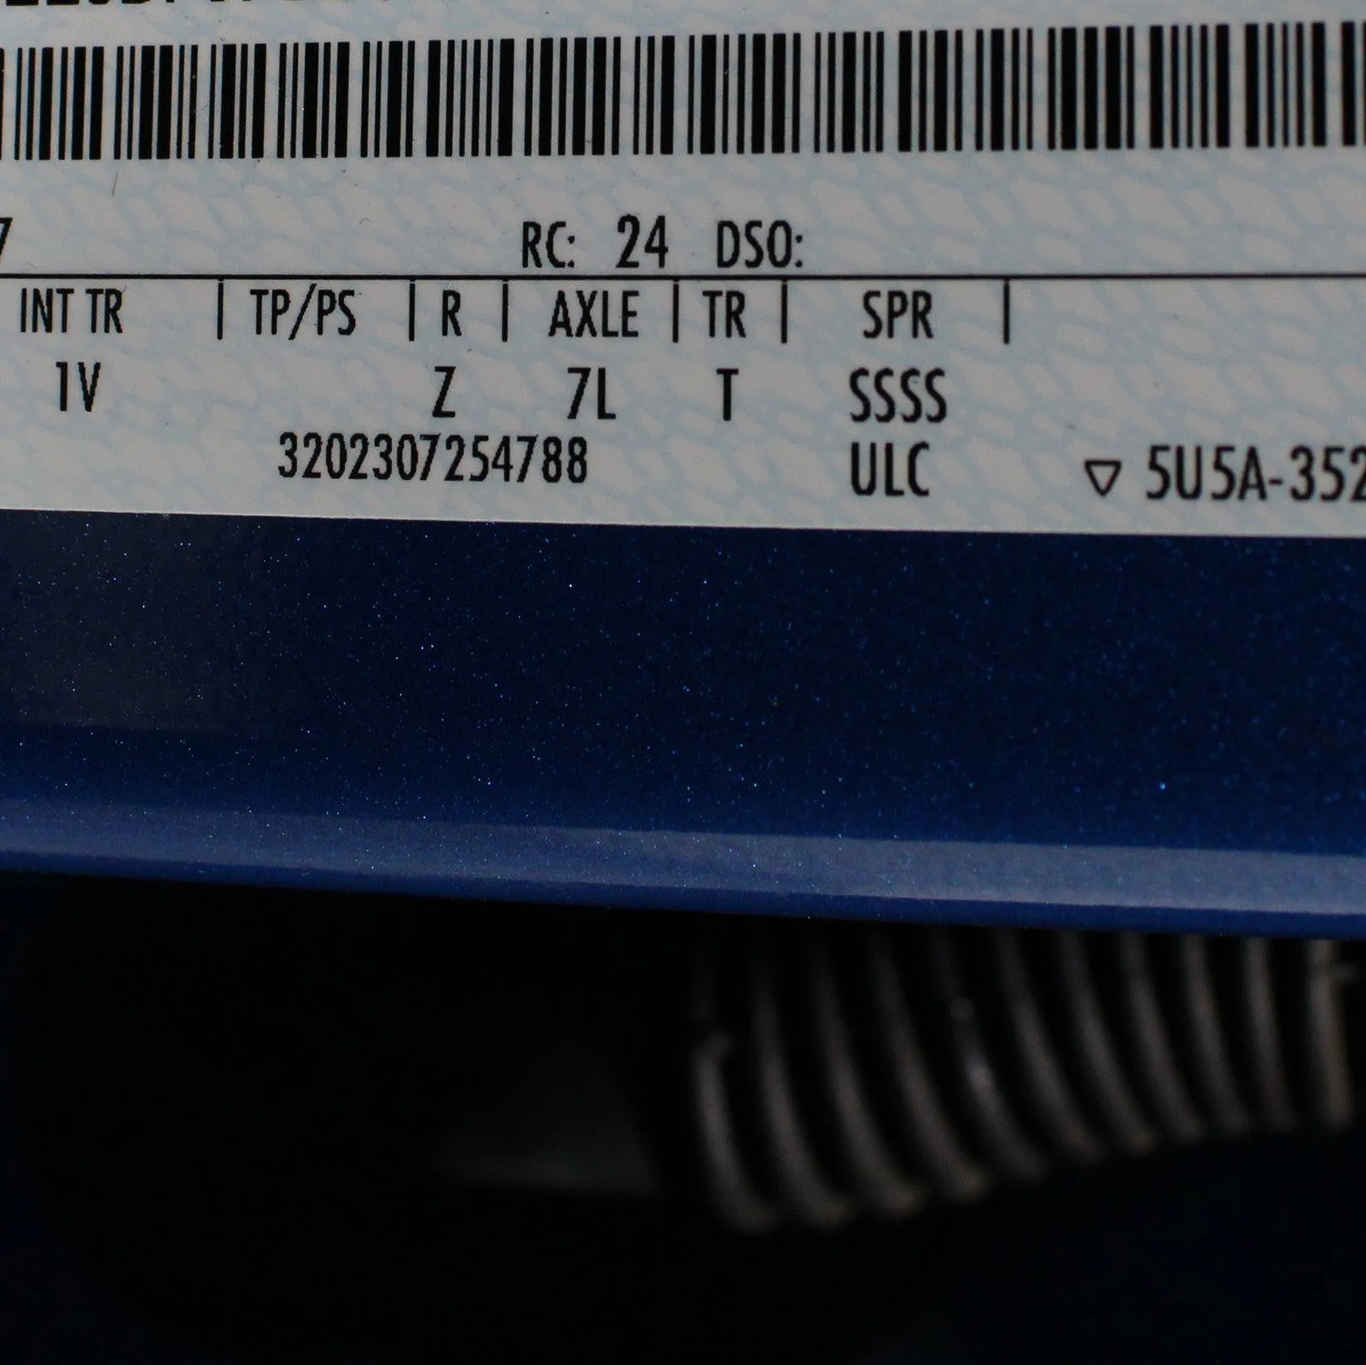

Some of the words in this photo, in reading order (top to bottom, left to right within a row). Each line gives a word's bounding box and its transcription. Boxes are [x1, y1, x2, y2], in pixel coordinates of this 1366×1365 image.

[522, 221, 575, 268] RC:
[616, 214, 668, 268] 24
[717, 220, 803, 268] DSO:
[21, 288, 74, 333] INT
[86, 288, 122, 333] TR
[250, 283, 356, 340] TP/PS
[442, 290, 462, 336] R
[548, 290, 639, 337] AXLE
[702, 290, 746, 338] TR
[863, 290, 933, 339] SPR
[56, 362, 101, 412] 1V
[432, 366, 456, 418] Z
[567, 367, 616, 420] 7L
[716, 368, 739, 421] T
[849, 367, 947, 423] SSSS
[278, 432, 587, 483] 3202307254788
[851, 441, 929, 497] ULC
